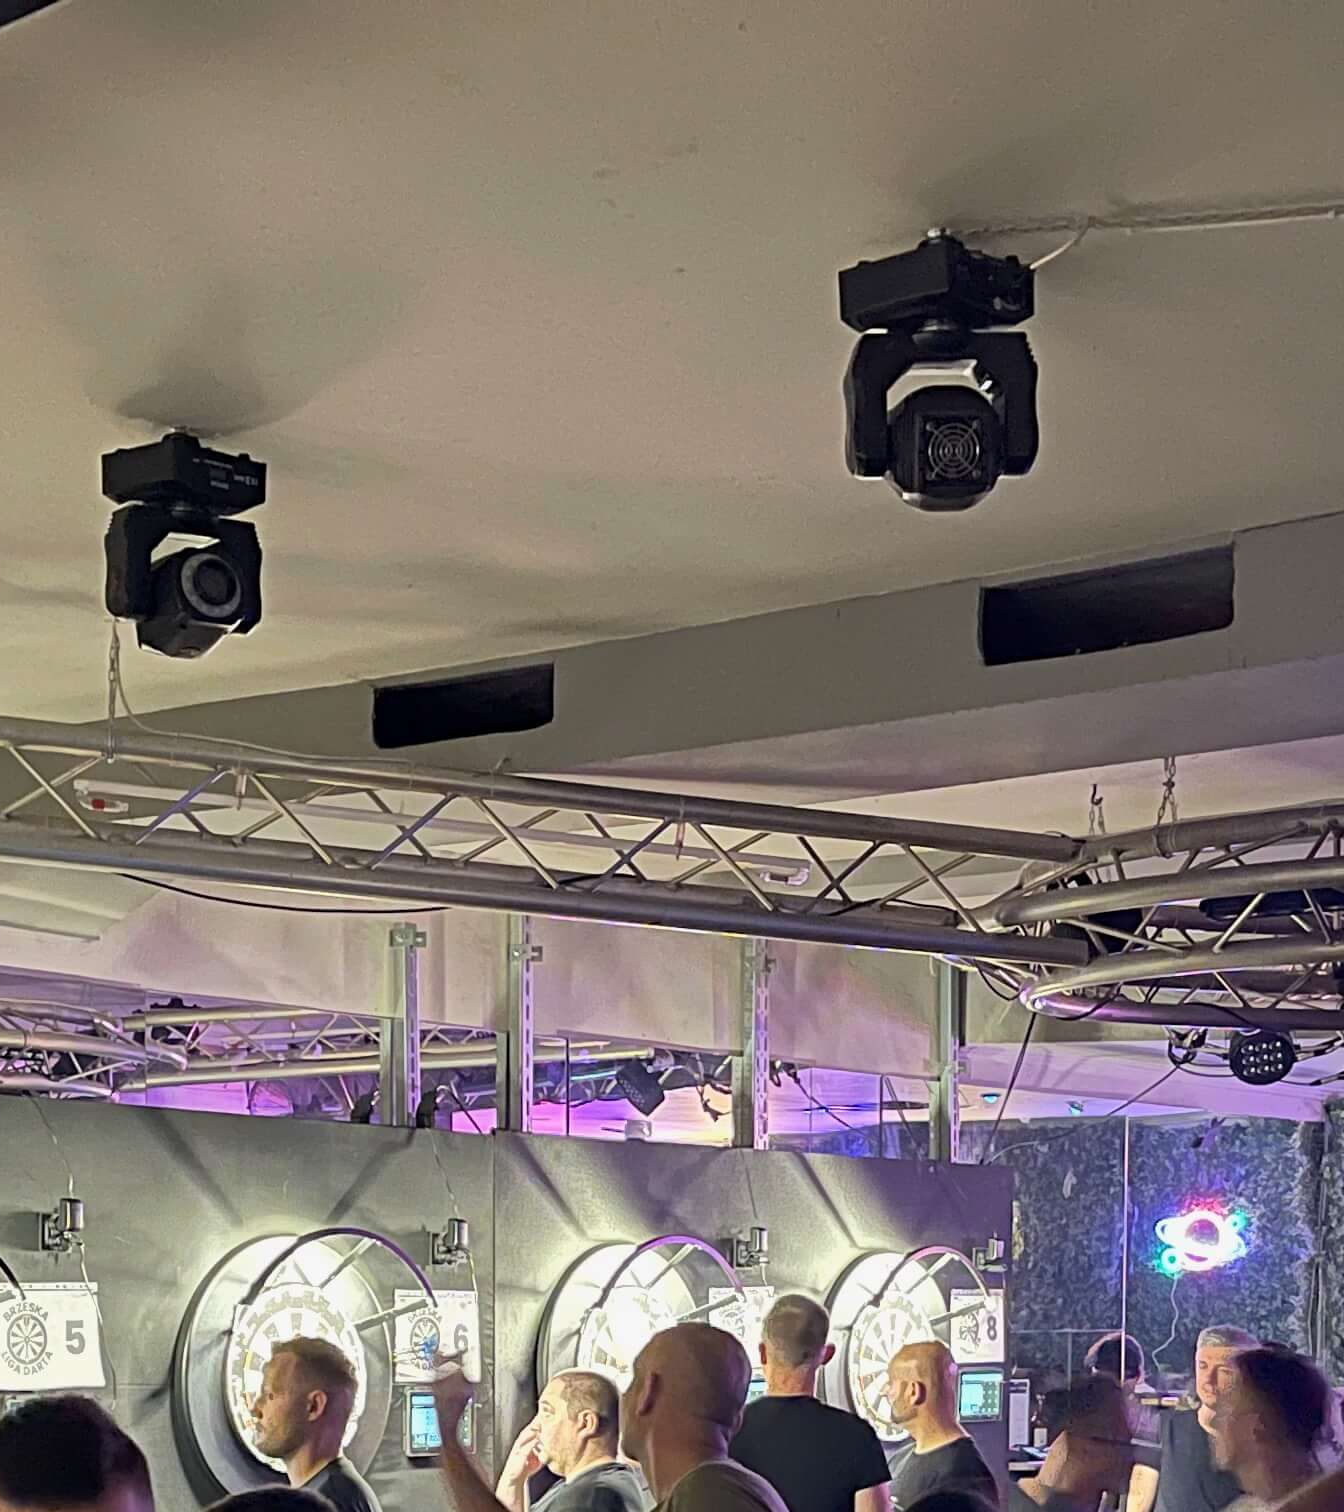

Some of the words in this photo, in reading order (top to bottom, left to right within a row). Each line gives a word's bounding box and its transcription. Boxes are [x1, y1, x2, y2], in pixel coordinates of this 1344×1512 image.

[3, 1302, 49, 1322] BRZESKA
[65, 1319, 86, 1355] 5
[454, 1323, 468, 1352] 6
[987, 1315, 997, 1341] 8
[1, 1351, 22, 1375] LIGA
[23, 1351, 54, 1376] DARTA
